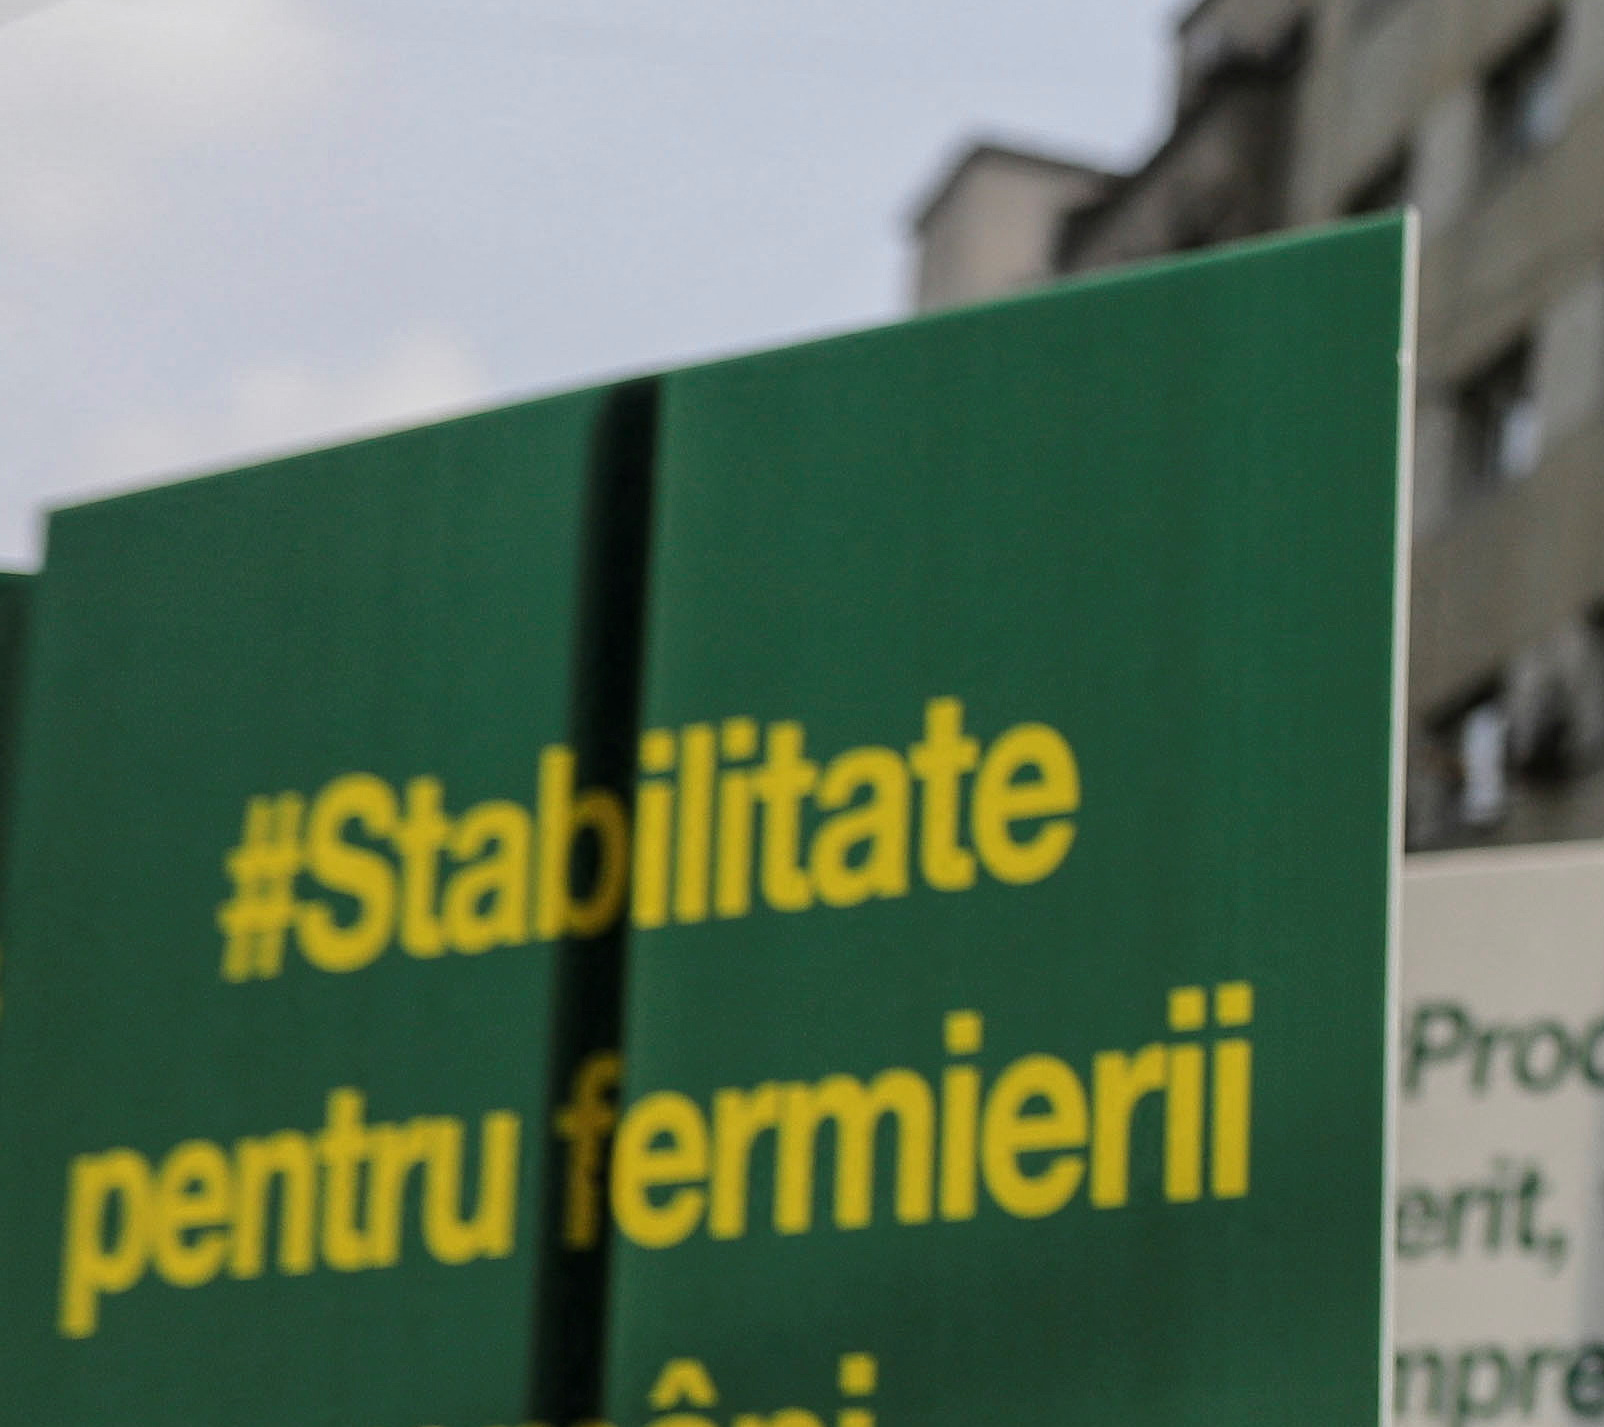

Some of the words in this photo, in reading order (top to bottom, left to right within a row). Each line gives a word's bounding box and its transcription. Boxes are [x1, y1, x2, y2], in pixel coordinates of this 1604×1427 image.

[218, 696, 1082, 982] #Stabilitate
[58, 1087, 521, 1340] pentru
[556, 981, 1255, 1250] fermierii
